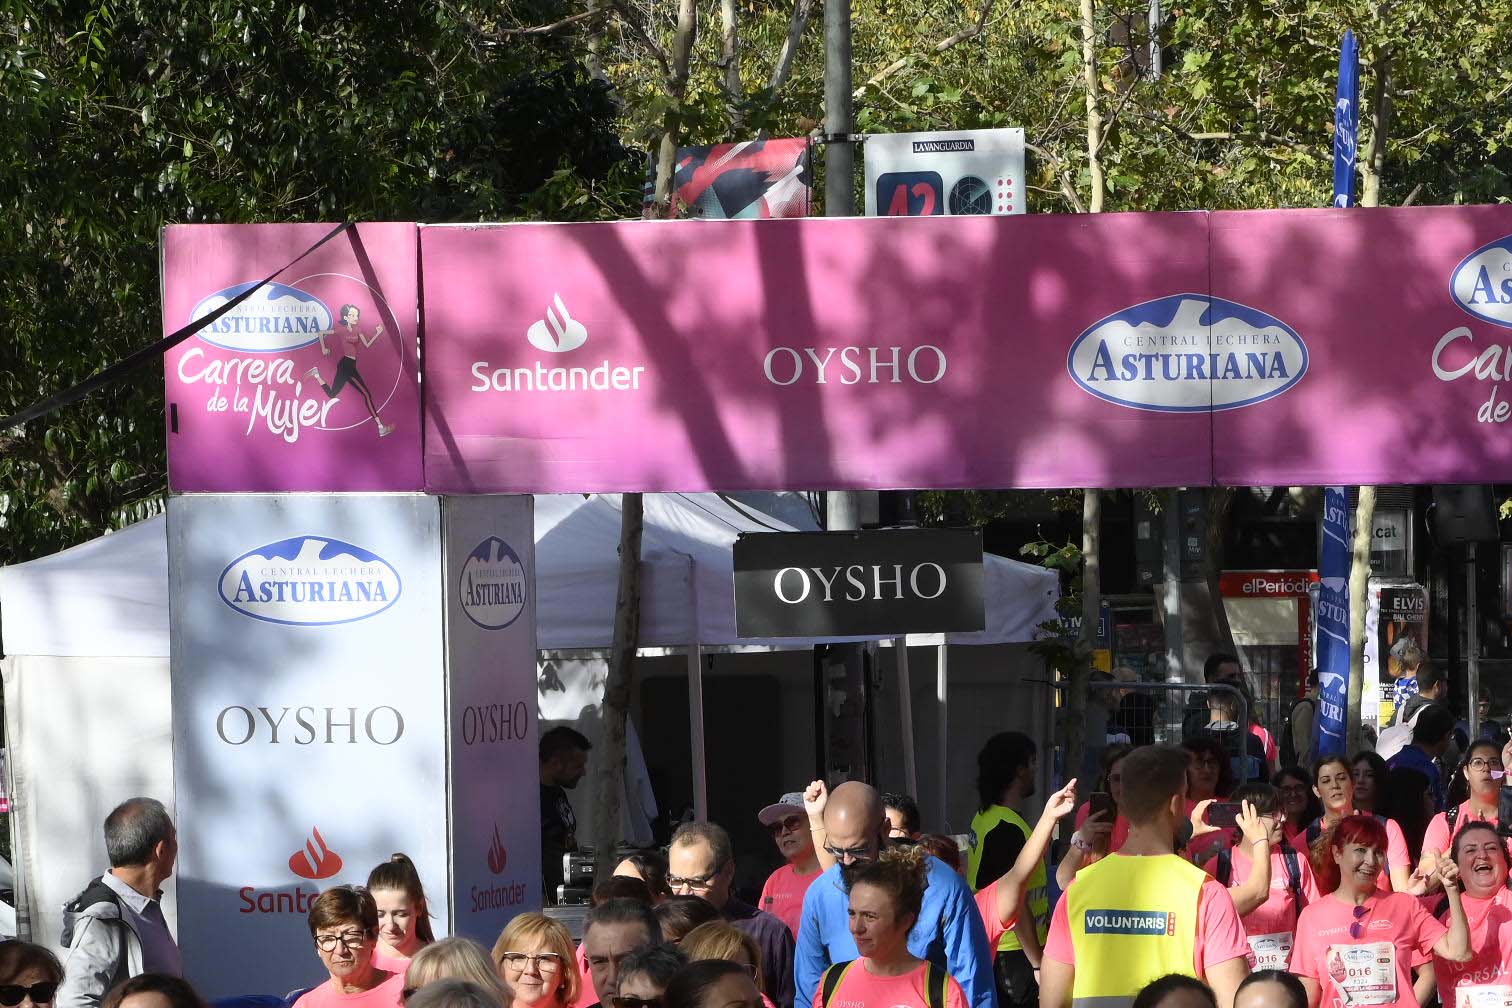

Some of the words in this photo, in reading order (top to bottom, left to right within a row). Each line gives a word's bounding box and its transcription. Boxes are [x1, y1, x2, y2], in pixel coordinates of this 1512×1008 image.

[201, 308, 321, 334] ASTURIANA
[1123, 334, 1197, 347] CENTRAL
[1206, 333, 1281, 346] LECHERA
[178, 348, 295, 384] Carrera
[471, 361, 645, 393] Santander
[764, 344, 947, 386] OYSHO
[1087, 339, 1289, 383] ASTURIANA
[207, 386, 228, 412] de
[233, 386, 249, 412] la
[247, 381, 340, 443] Mujer
[1477, 388, 1510, 424] de
[233, 569, 388, 604] ASTURIANA
[260, 567, 318, 577] CENTRAL
[774, 562, 947, 604] OYSHO
[465, 573, 524, 607] ASTURIANA
[1393, 597, 1424, 610] ELVIS
[216, 705, 405, 745] OYSHO
[463, 701, 528, 746] OYSHO
[471, 882, 527, 913] Santander
[1086, 915, 1165, 930] VOLUNTARIS
[1348, 966, 1372, 977] 016
